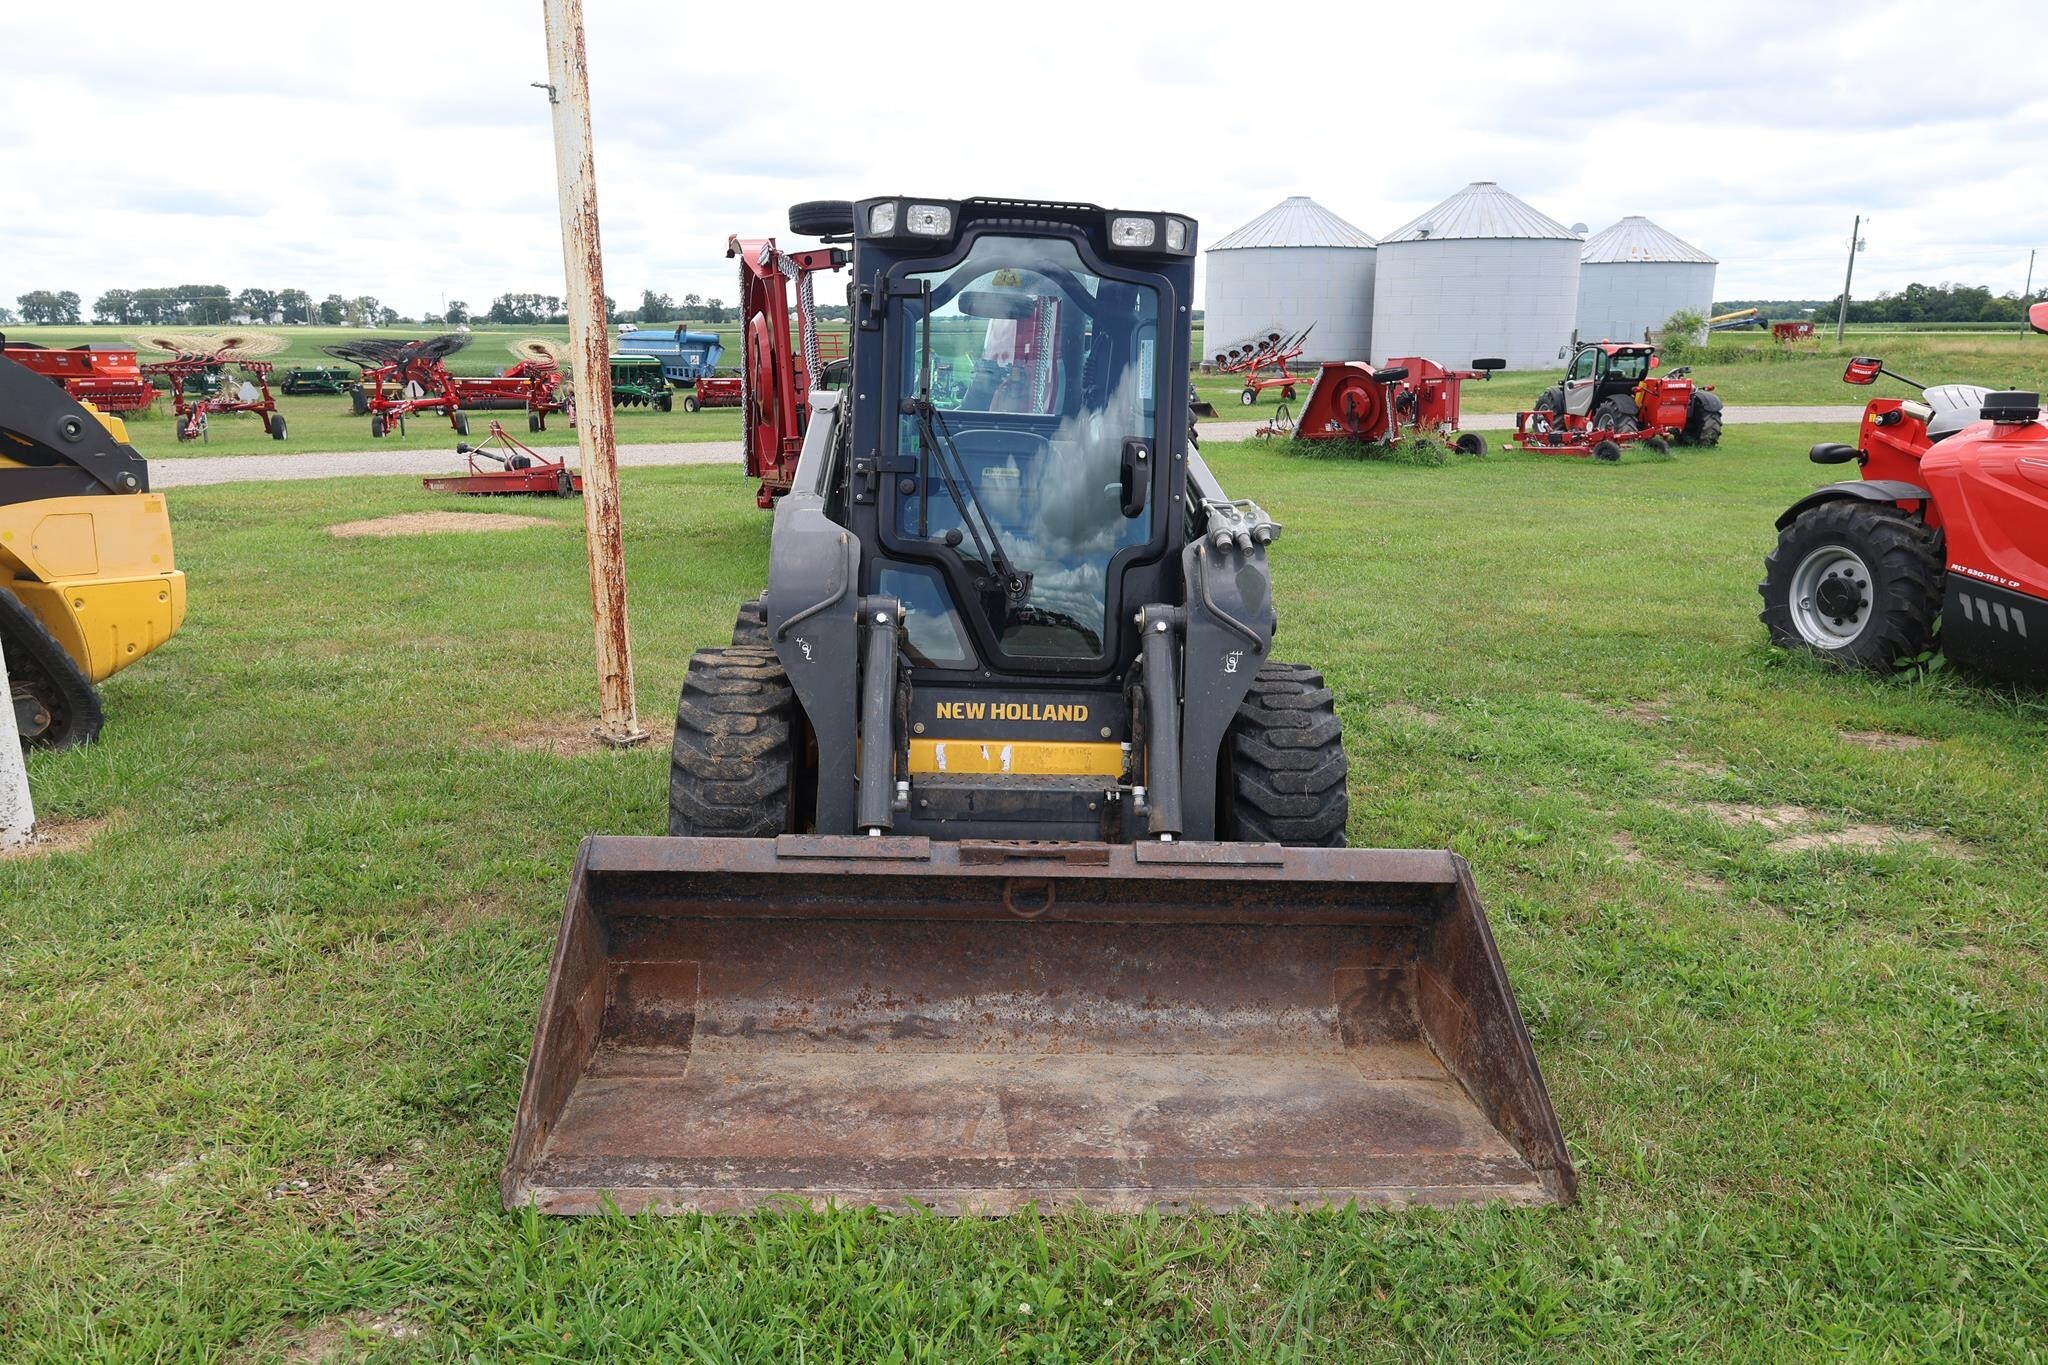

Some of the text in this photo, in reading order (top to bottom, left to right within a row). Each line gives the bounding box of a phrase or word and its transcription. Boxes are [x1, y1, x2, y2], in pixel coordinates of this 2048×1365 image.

[1951, 564, 1967, 572] MLT
[1967, 569, 1999, 582] 630-115
[2008, 580, 2020, 588] CP
[936, 702, 1089, 722] NEW HOLLAND
